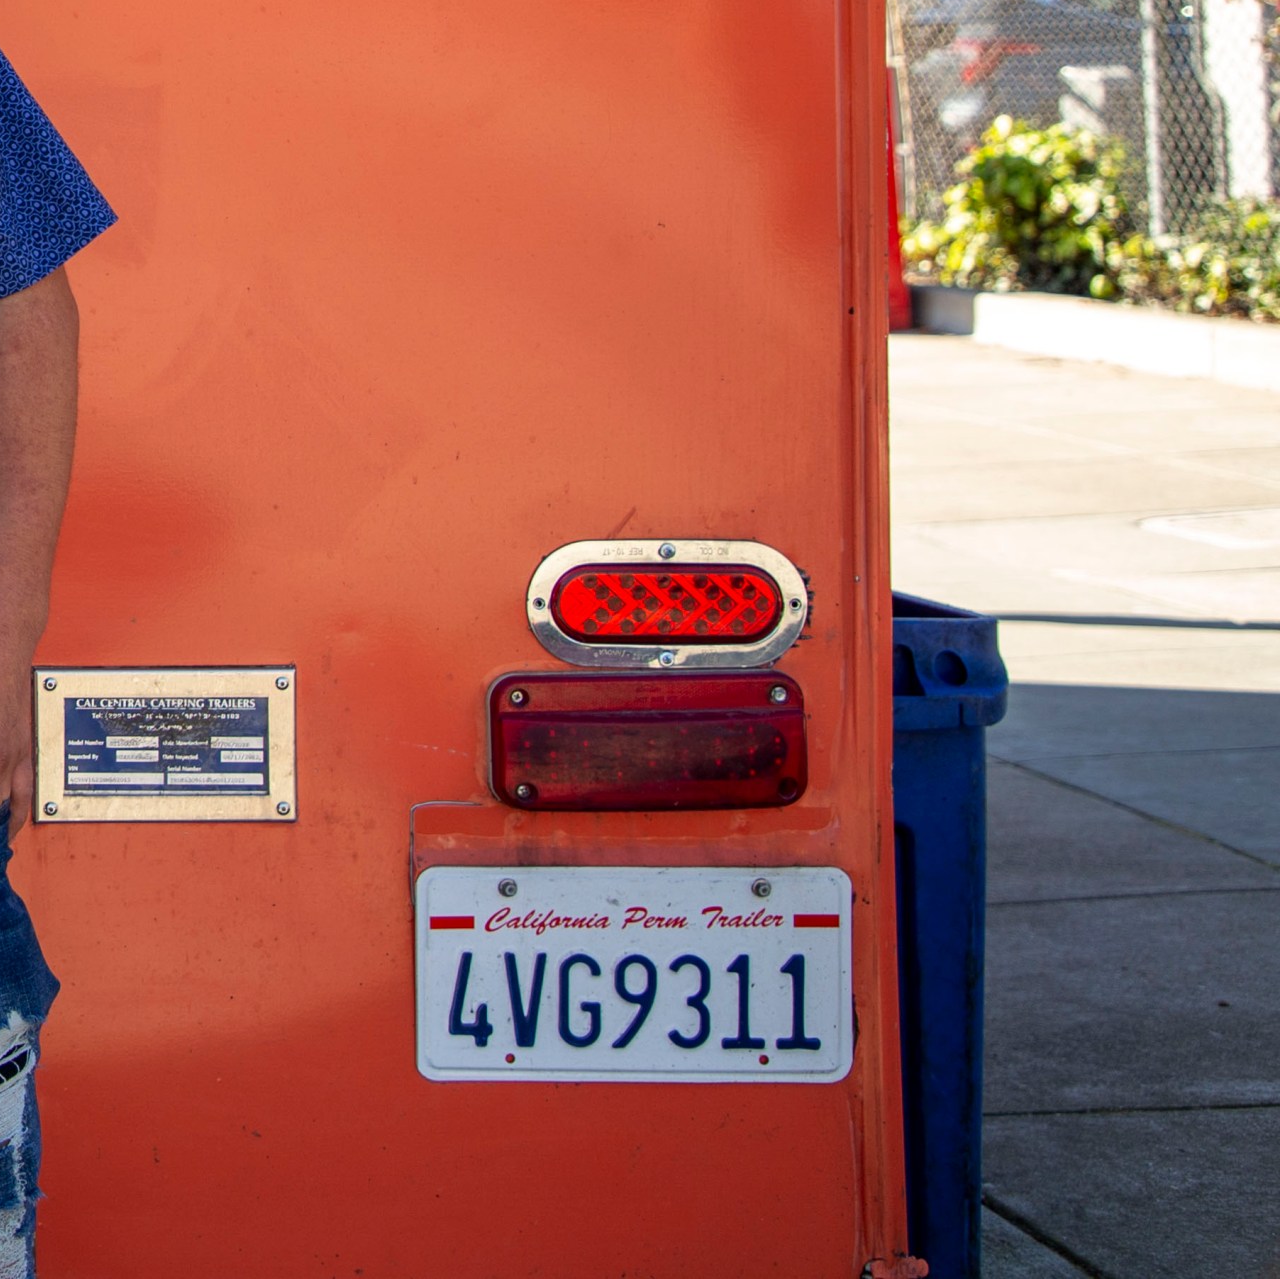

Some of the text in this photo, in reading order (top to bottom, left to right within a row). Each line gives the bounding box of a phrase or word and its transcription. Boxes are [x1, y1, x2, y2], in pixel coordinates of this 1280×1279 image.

[76, 698, 256, 709] CAL CENTRAL CATERING TRAILERS
[484, 905, 785, 936] California Perm Trailer
[448, 951, 822, 1051] 4VG9311
